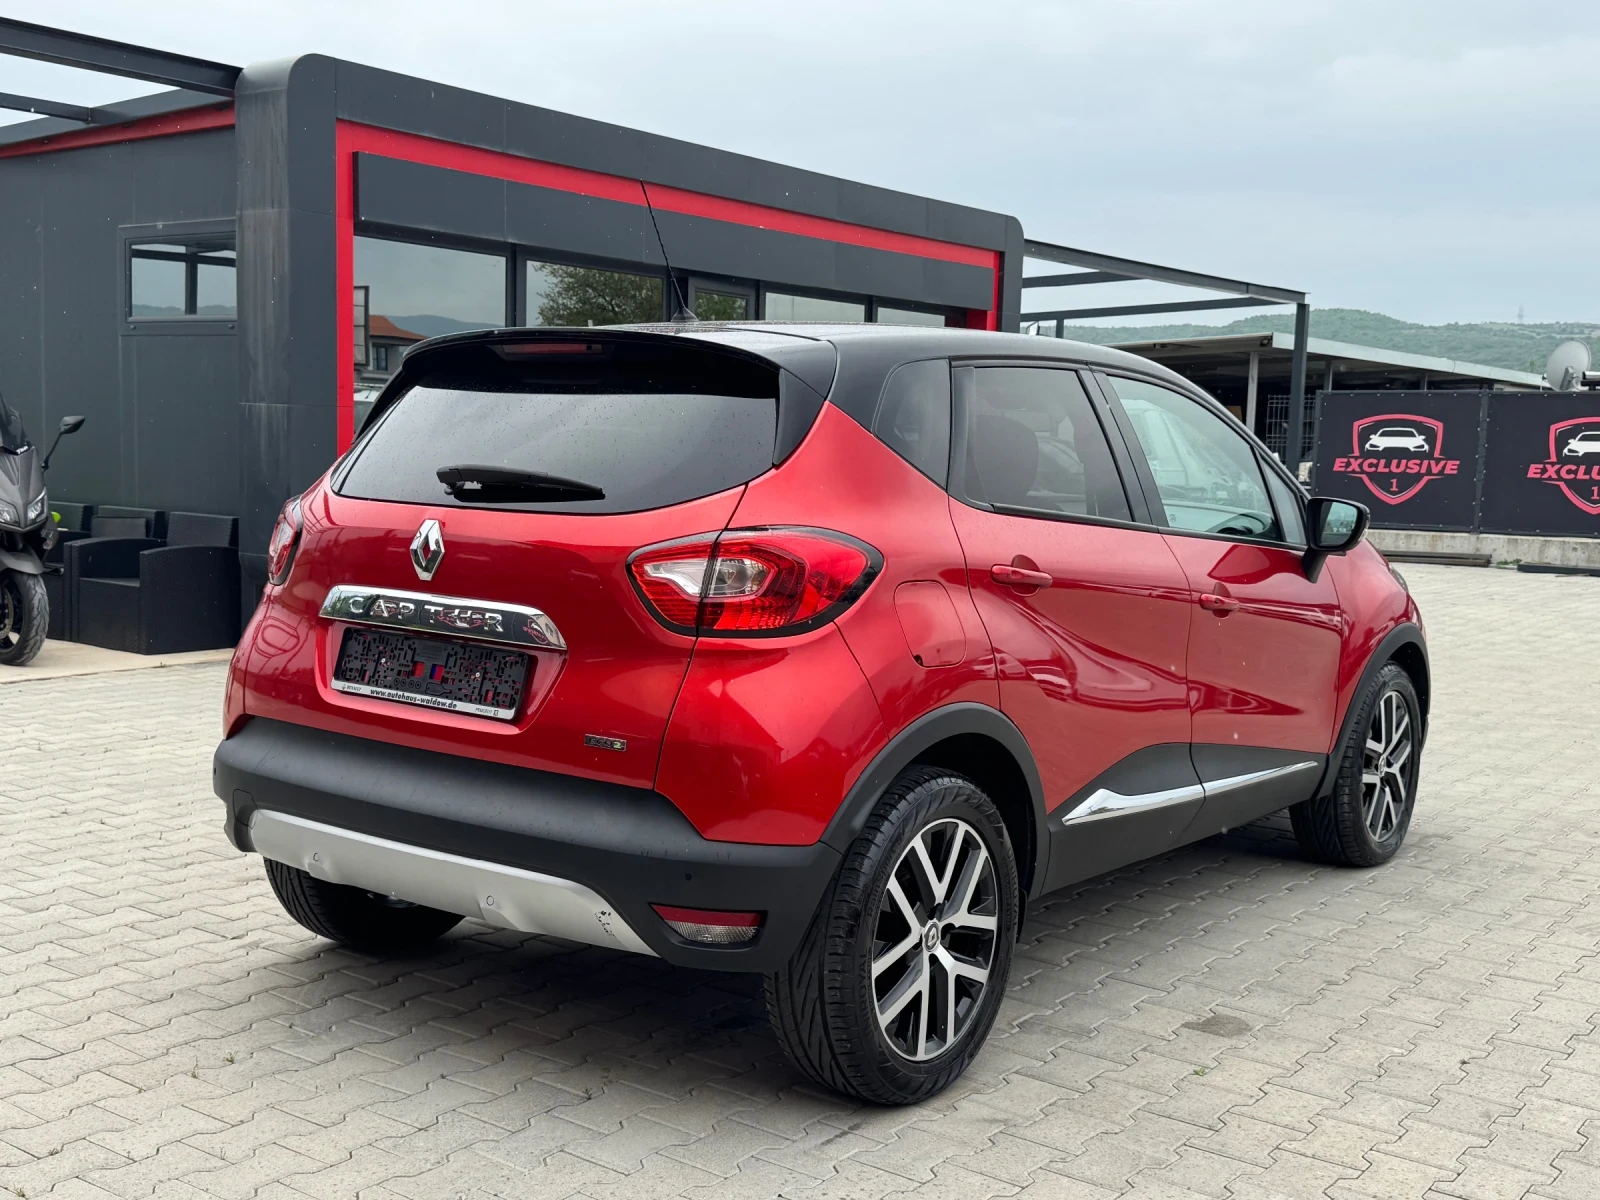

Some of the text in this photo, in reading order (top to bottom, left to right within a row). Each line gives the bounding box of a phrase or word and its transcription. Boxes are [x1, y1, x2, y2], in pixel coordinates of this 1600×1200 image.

[1332, 457, 1461, 475] EXCLUSIVE
[1389, 478, 1399, 491] 1
[1591, 485, 1600, 500] 1
[347, 596, 504, 632] CAPTUR
[370, 688, 458, 710] www.autohaus-waldow.de
